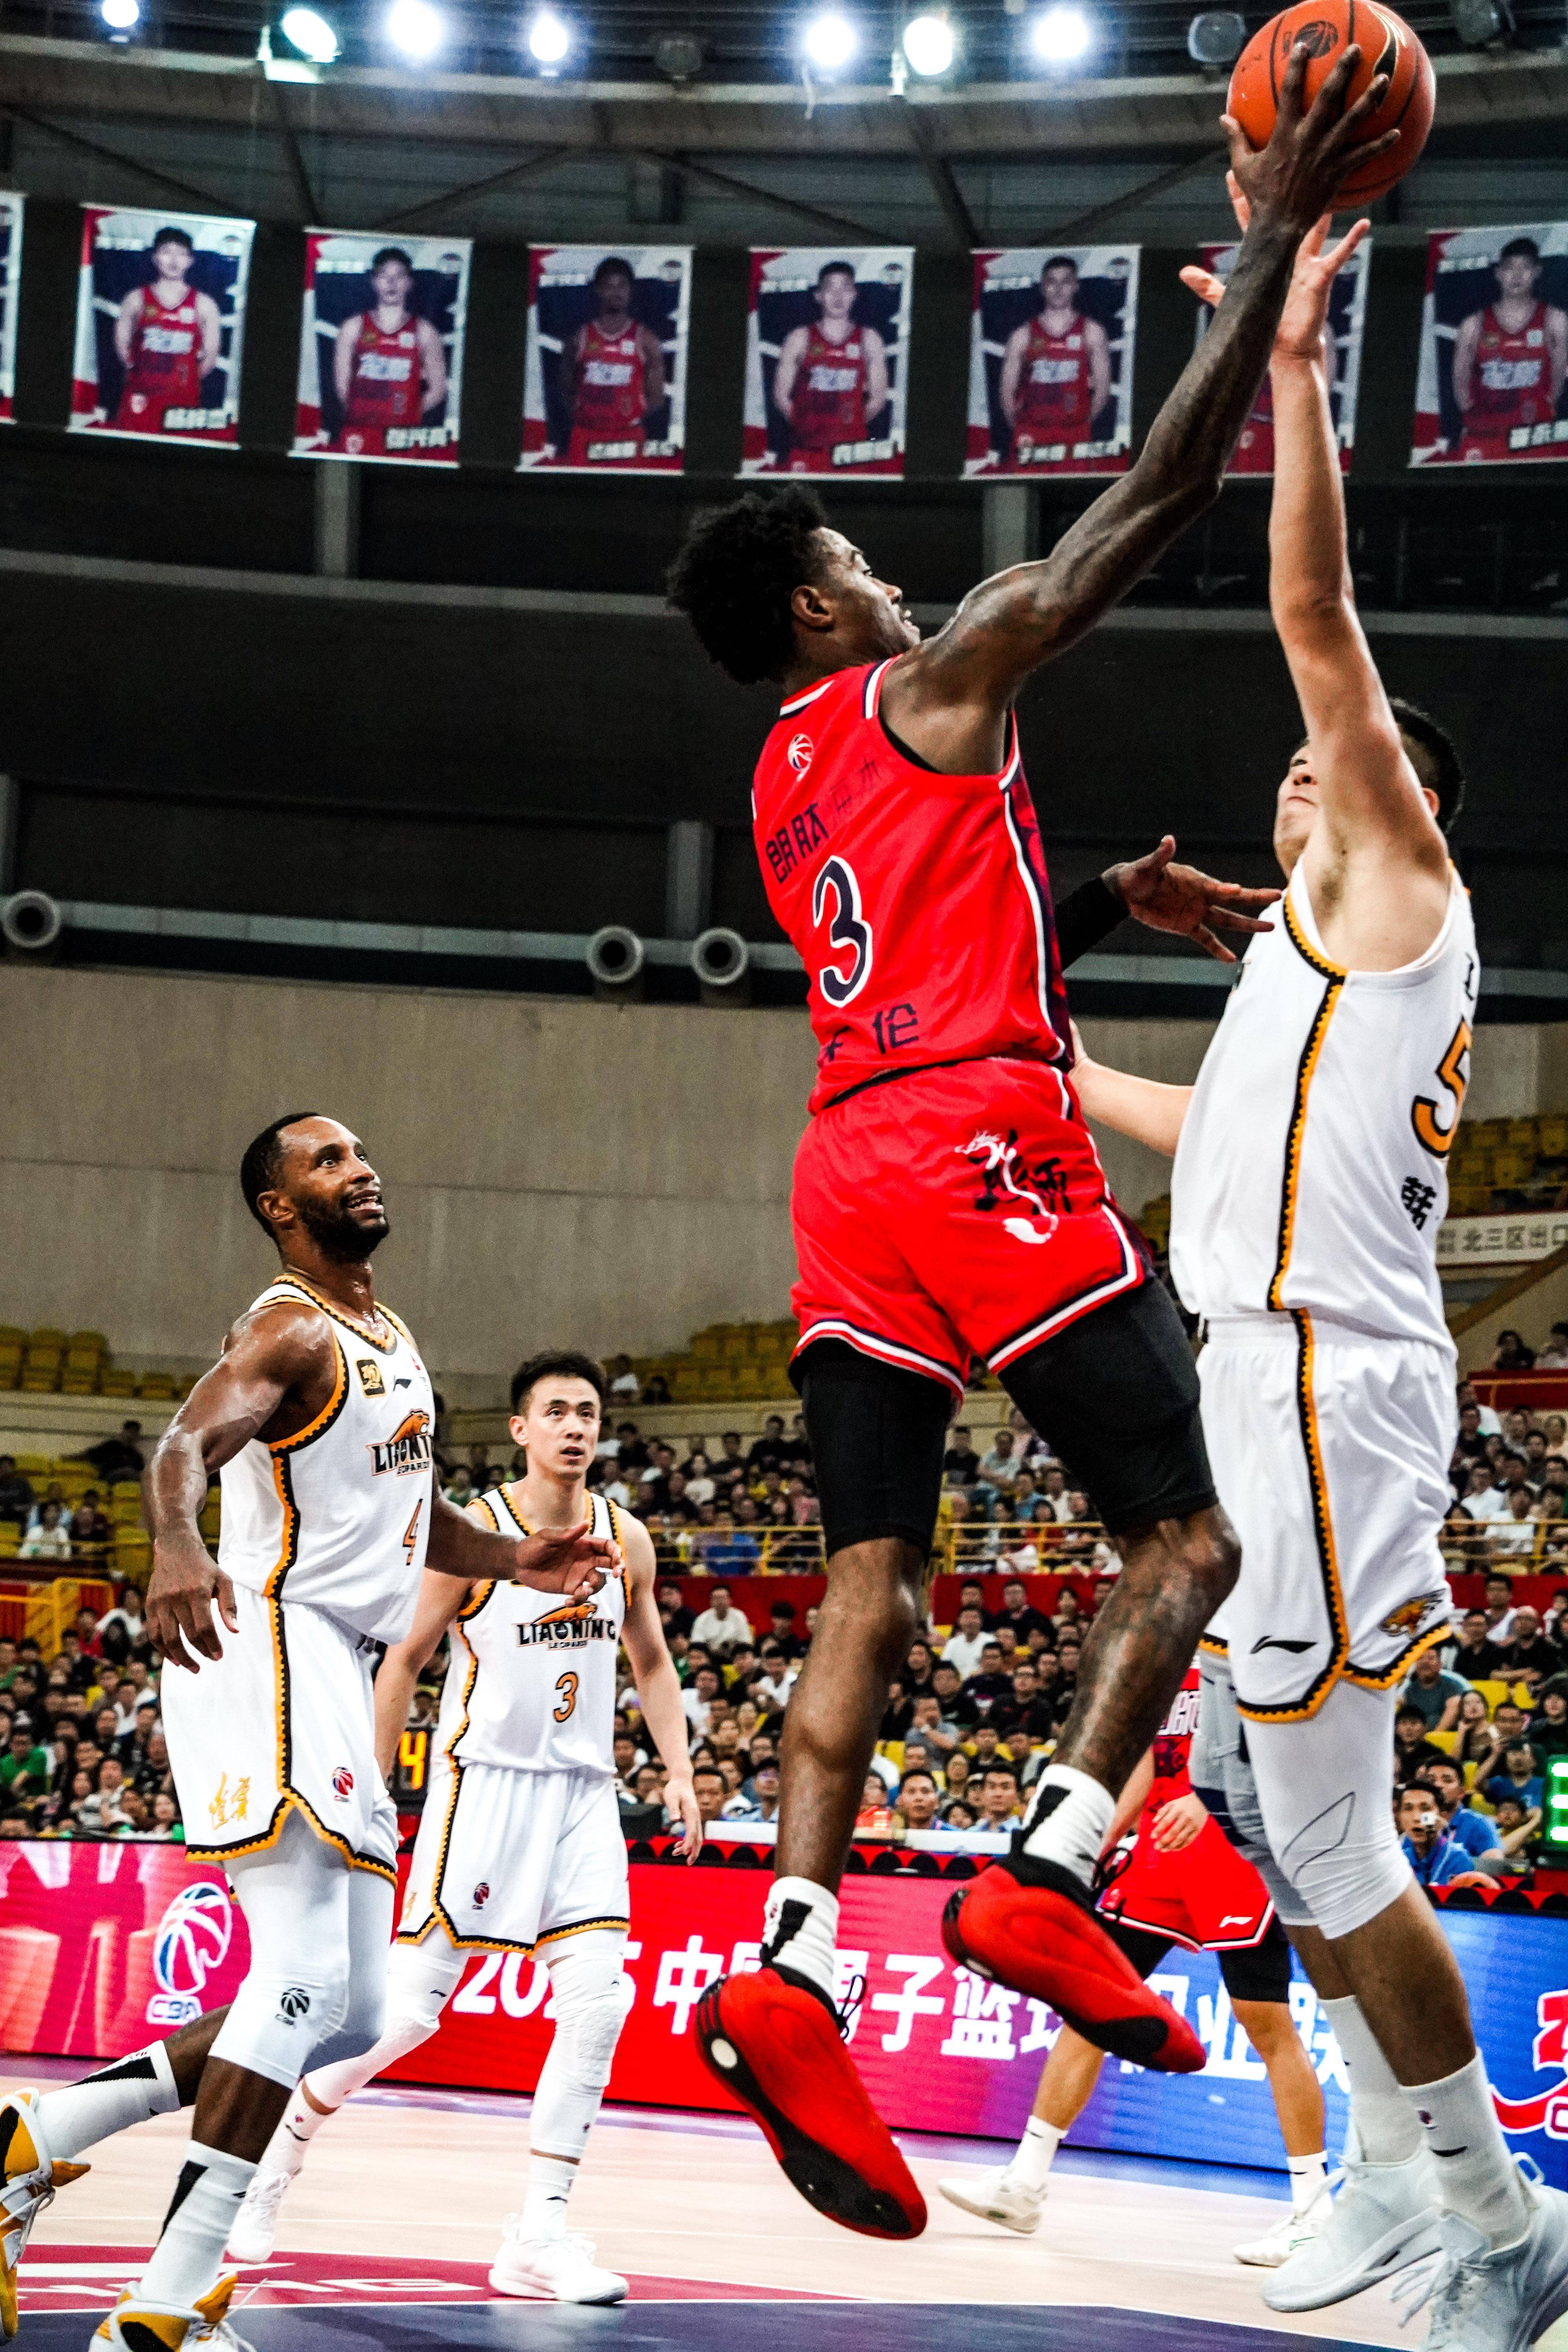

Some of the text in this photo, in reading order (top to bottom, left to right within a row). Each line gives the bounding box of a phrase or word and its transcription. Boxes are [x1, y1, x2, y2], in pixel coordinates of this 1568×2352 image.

[813, 855, 872, 1008] 3
[403, 1498, 423, 1566] 4
[517, 1619, 615, 1645] LIAONING
[554, 1671, 579, 1723] 3
[399, 1731, 427, 1790] 4
